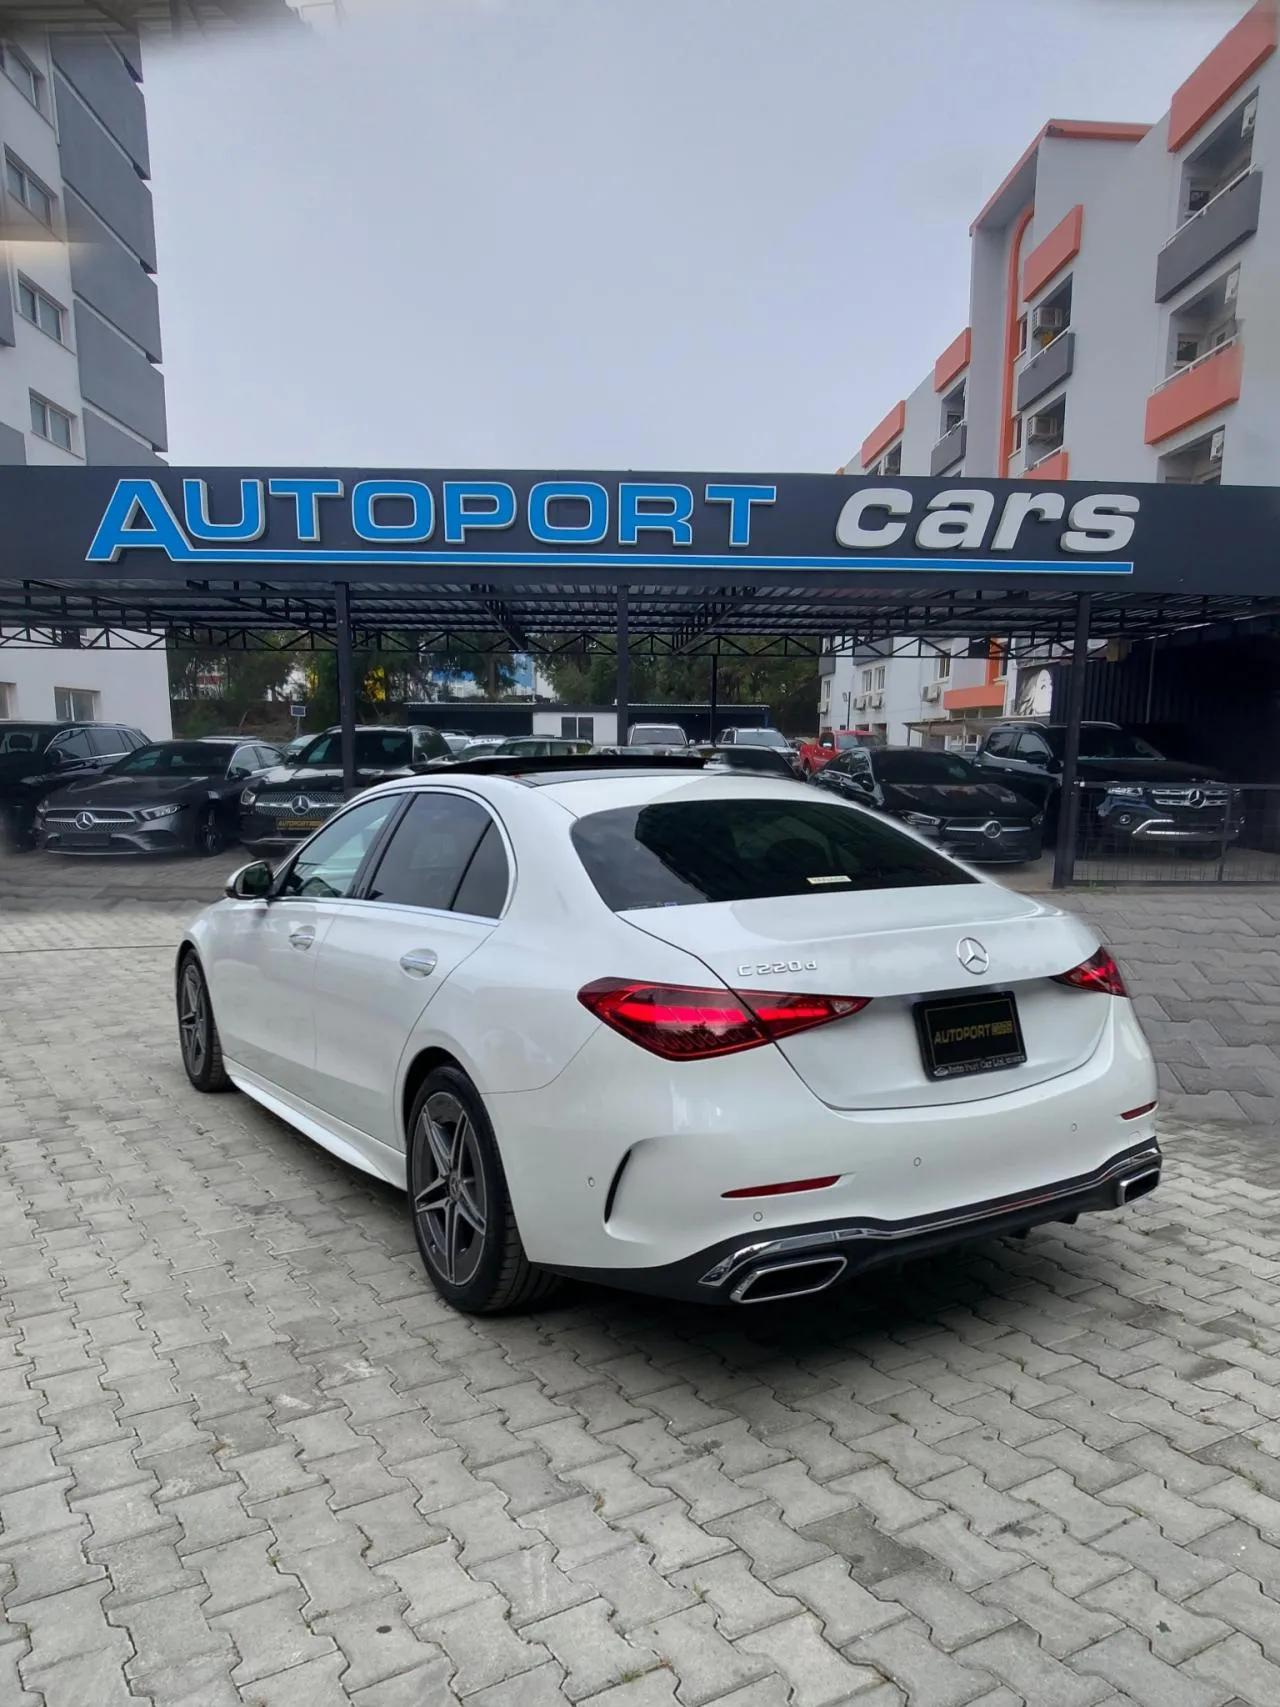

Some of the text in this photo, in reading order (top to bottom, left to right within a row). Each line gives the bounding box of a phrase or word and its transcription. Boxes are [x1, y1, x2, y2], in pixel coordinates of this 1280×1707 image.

[85, 478, 1141, 562] AUTOPORT cars
[934, 1024, 991, 1044] AUTOPORT
